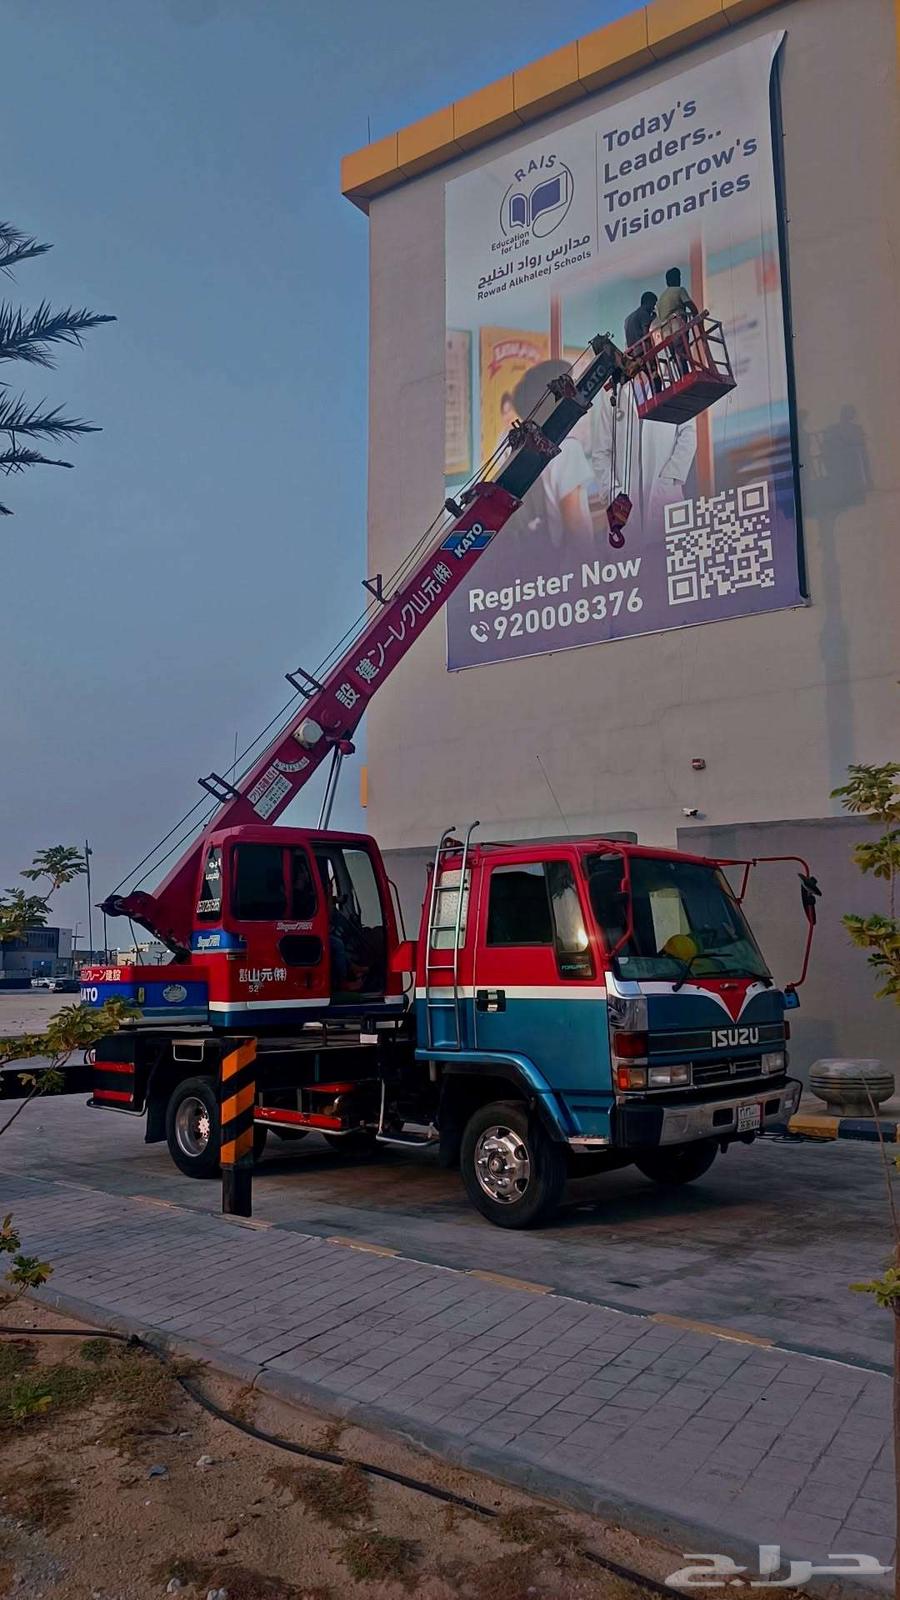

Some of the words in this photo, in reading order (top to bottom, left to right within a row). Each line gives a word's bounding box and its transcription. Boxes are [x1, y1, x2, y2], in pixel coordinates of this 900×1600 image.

[603, 100, 696, 152] Today's
[514, 154, 557, 182] RAIS
[604, 127, 721, 184] Leaders..
[604, 138, 757, 212] Tomorrow's
[604, 174, 750, 243] Visionaries
[491, 231, 530, 251] Education
[501, 245, 513, 255] for
[514, 239, 530, 250] Life
[546, 235, 590, 262] مدارس
[477, 262, 514, 289] الخليج
[477, 283, 507, 301] Rowad
[509, 266, 551, 289] Alkhaleej
[554, 251, 591, 271] Schools
[517, 254, 542, 269] رواد
[454, 523, 482, 558] KATO
[469, 572, 574, 613] Register
[582, 557, 642, 588] Now
[494, 587, 643, 640] 920008376
[711, 1027, 759, 1048] ISUZU
